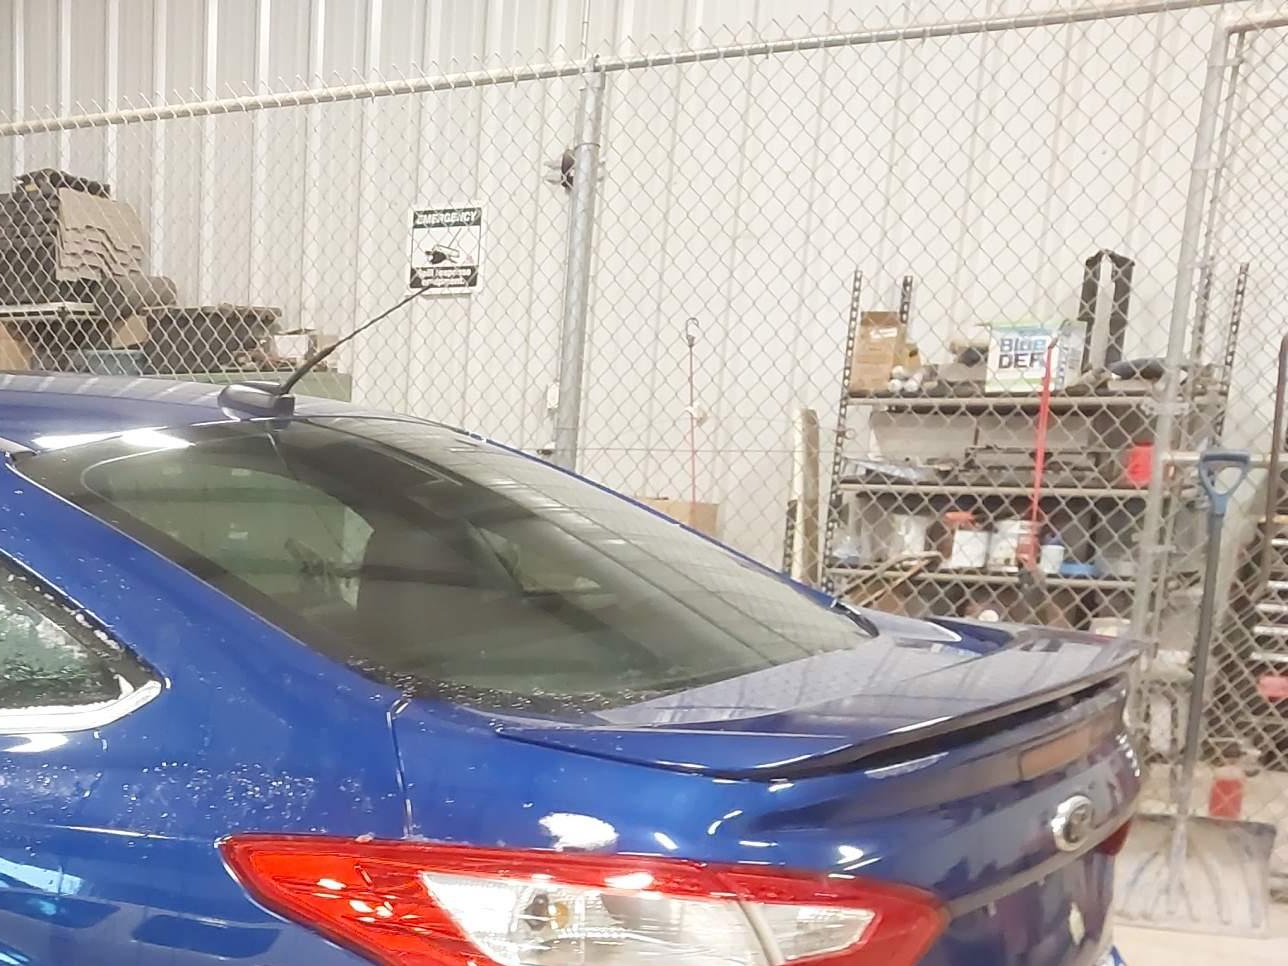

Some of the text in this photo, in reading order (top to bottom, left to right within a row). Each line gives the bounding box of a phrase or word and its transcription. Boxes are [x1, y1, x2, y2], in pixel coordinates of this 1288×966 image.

[415, 211, 477, 225] EMERGENCY
[999, 337, 1046, 352] Blue
[998, 352, 1045, 369] DEF
